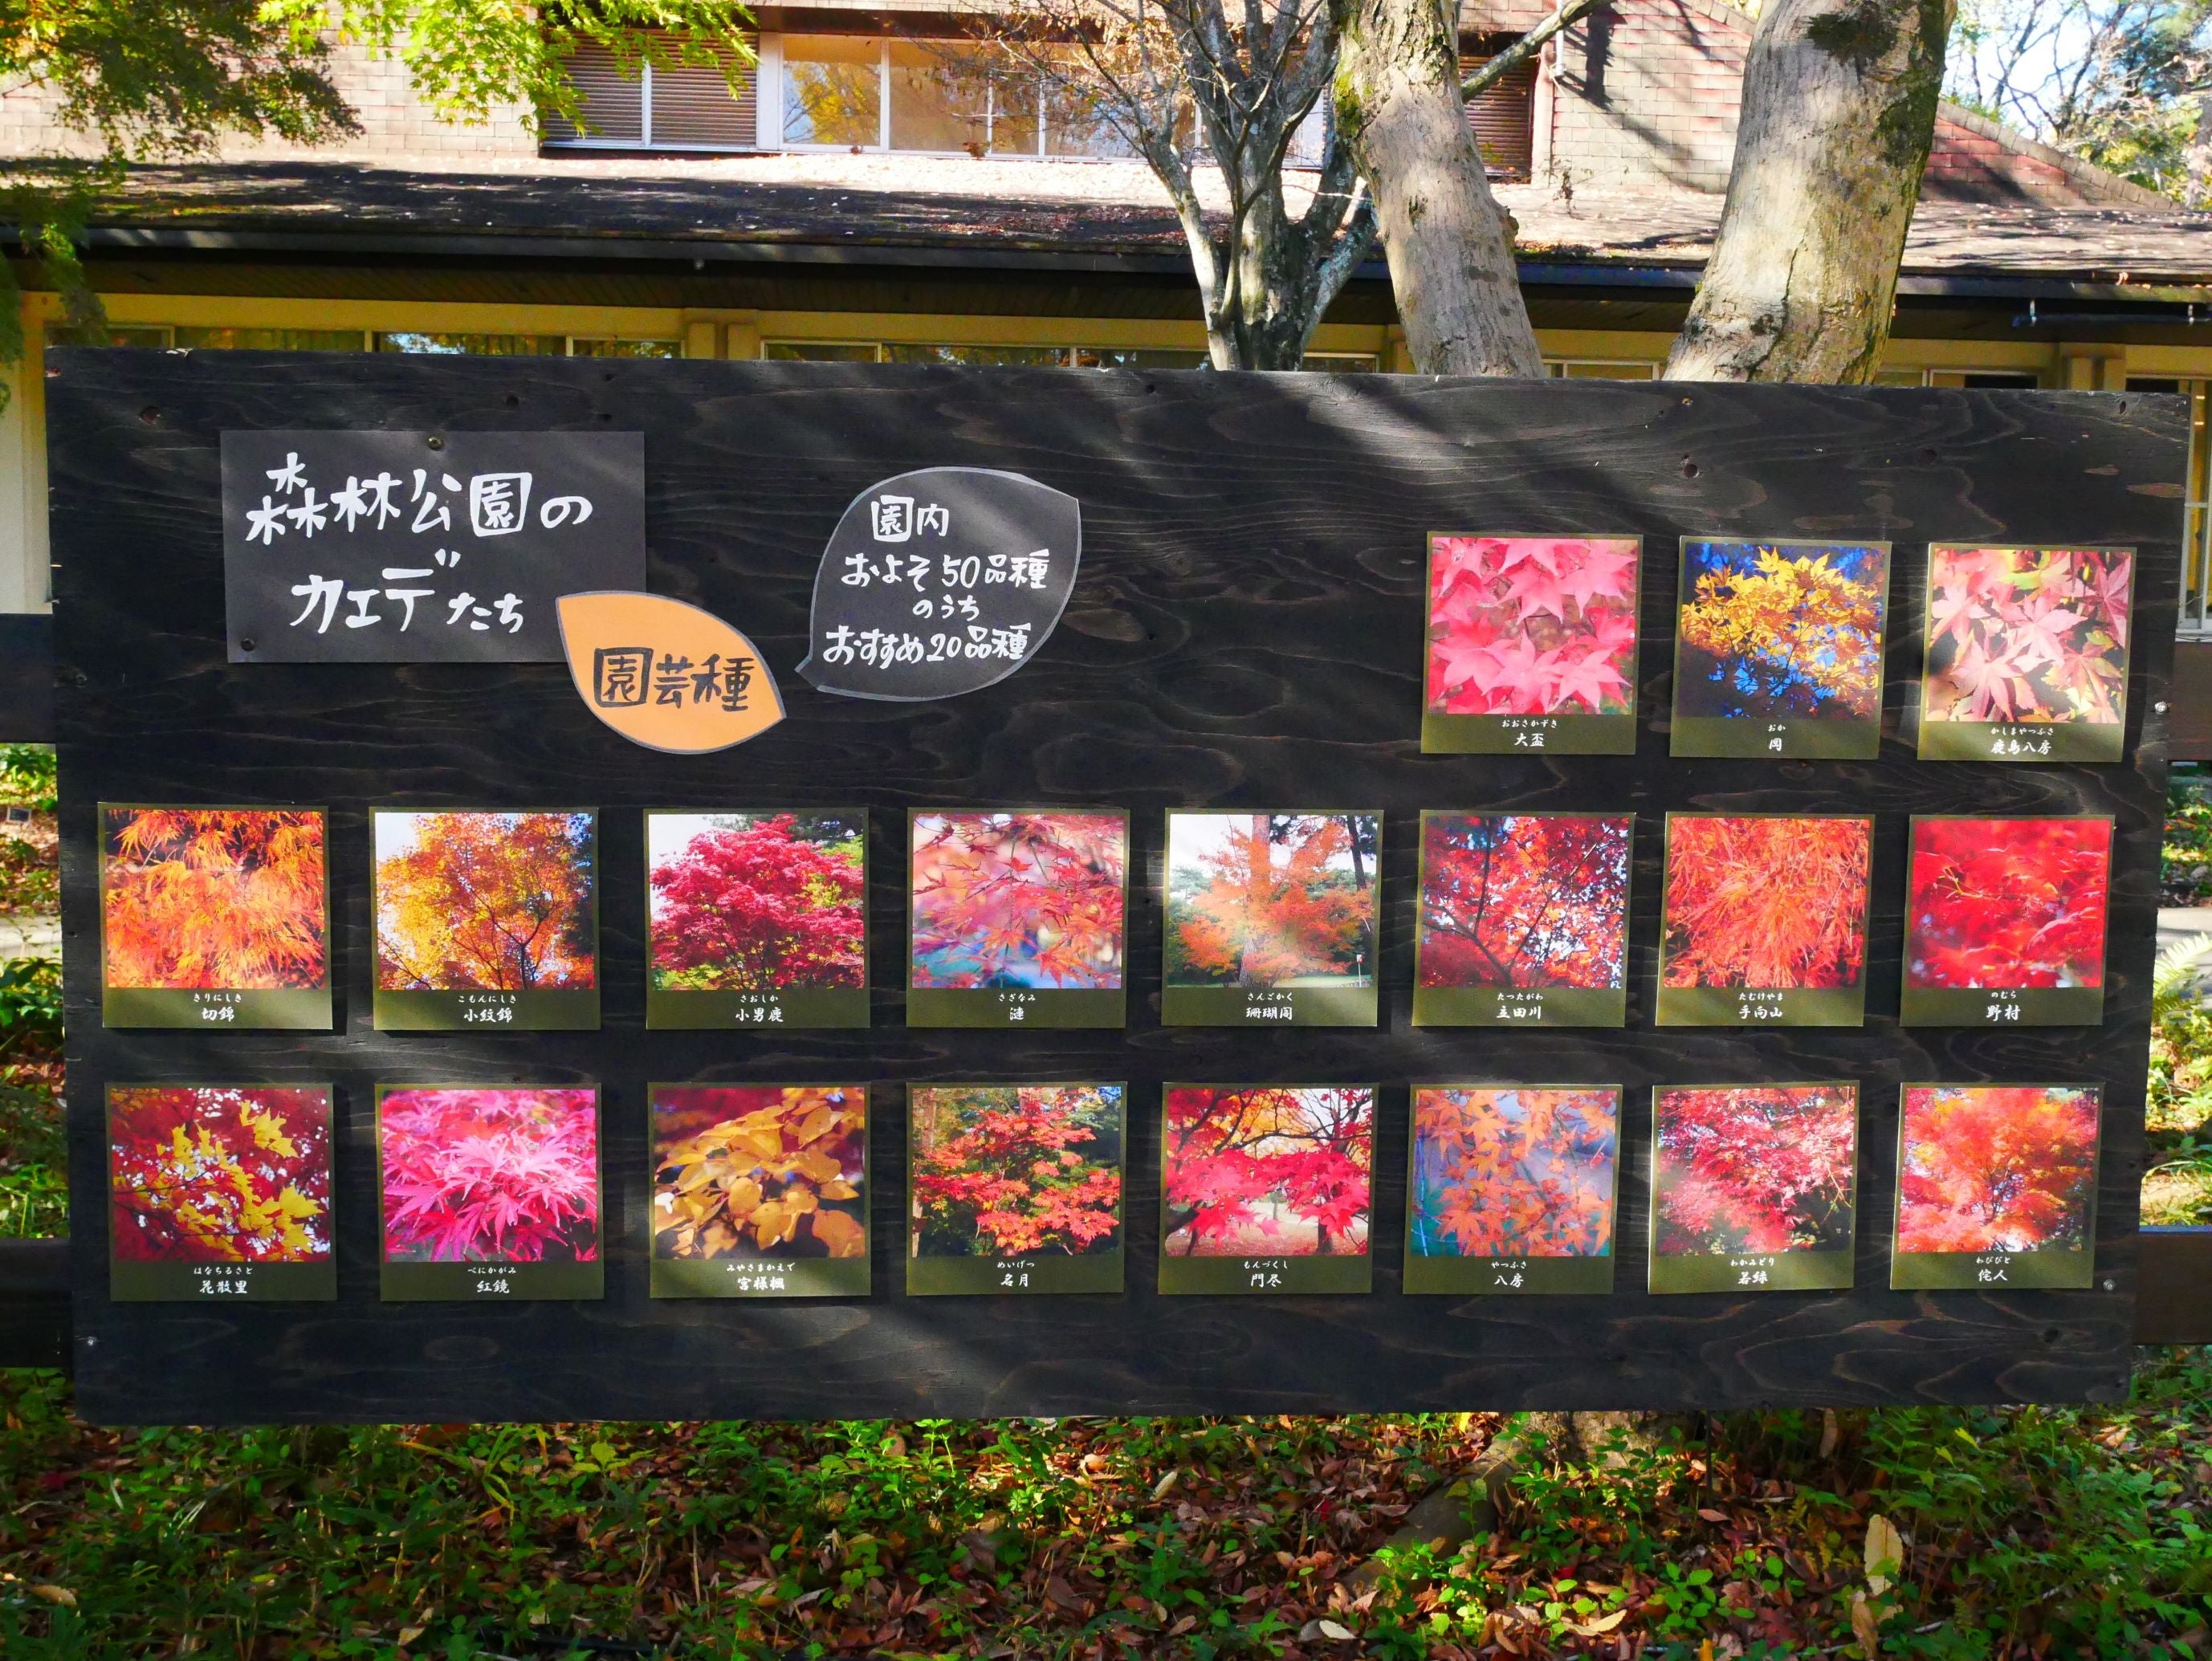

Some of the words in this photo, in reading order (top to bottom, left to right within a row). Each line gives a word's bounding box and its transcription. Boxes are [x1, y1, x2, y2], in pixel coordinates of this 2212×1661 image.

[246, 453, 593, 544] 森林公園の
[871, 495, 948, 542] 園内
[841, 549, 1050, 590] およそ50品種
[290, 549, 523, 633] カエデたち
[913, 596, 979, 621] のうち
[823, 624, 1029, 666] おすすめ20品種
[594, 649, 754, 712] 園芸種
[1501, 719, 1557, 729] おおさかずき
[1768, 724, 1786, 732] おか
[1990, 727, 2054, 736] かしまやつふさ
[1769, 737, 1782, 752] 岡
[193, 992, 242, 1004] きりにしき
[458, 995, 516, 1004] こもんにしき
[740, 994, 779, 1004] さおしか
[999, 992, 1036, 1003] さざなみ
[1248, 991, 1293, 1001] さんごかく
[1497, 992, 1543, 1001] たつたがわ
[1739, 992, 1783, 1002] たむけやま
[1990, 990, 2017, 999] のむら
[202, 1006, 234, 1022] 切錦
[735, 1006, 784, 1023] 小男鹿
[1496, 1005, 1542, 1020] 立田川
[1738, 1004, 1783, 1020] 手向山
[1986, 1004, 2021, 1022] 野村
[996, 1260, 1035, 1269] めいげつ
[1490, 1260, 1526, 1269] やつふさ
[1730, 1257, 1774, 1267] わかみどり
[1976, 1256, 2010, 1264] わびびと
[193, 1266, 253, 1276] はなちるさと
[199, 1280, 247, 1294] 花散里
[476, 1279, 510, 1294] 紅鏡
[1000, 1272, 1029, 1288] 名月
[1250, 1272, 1281, 1288] 門尽
[1494, 1273, 1524, 1288] 八房
